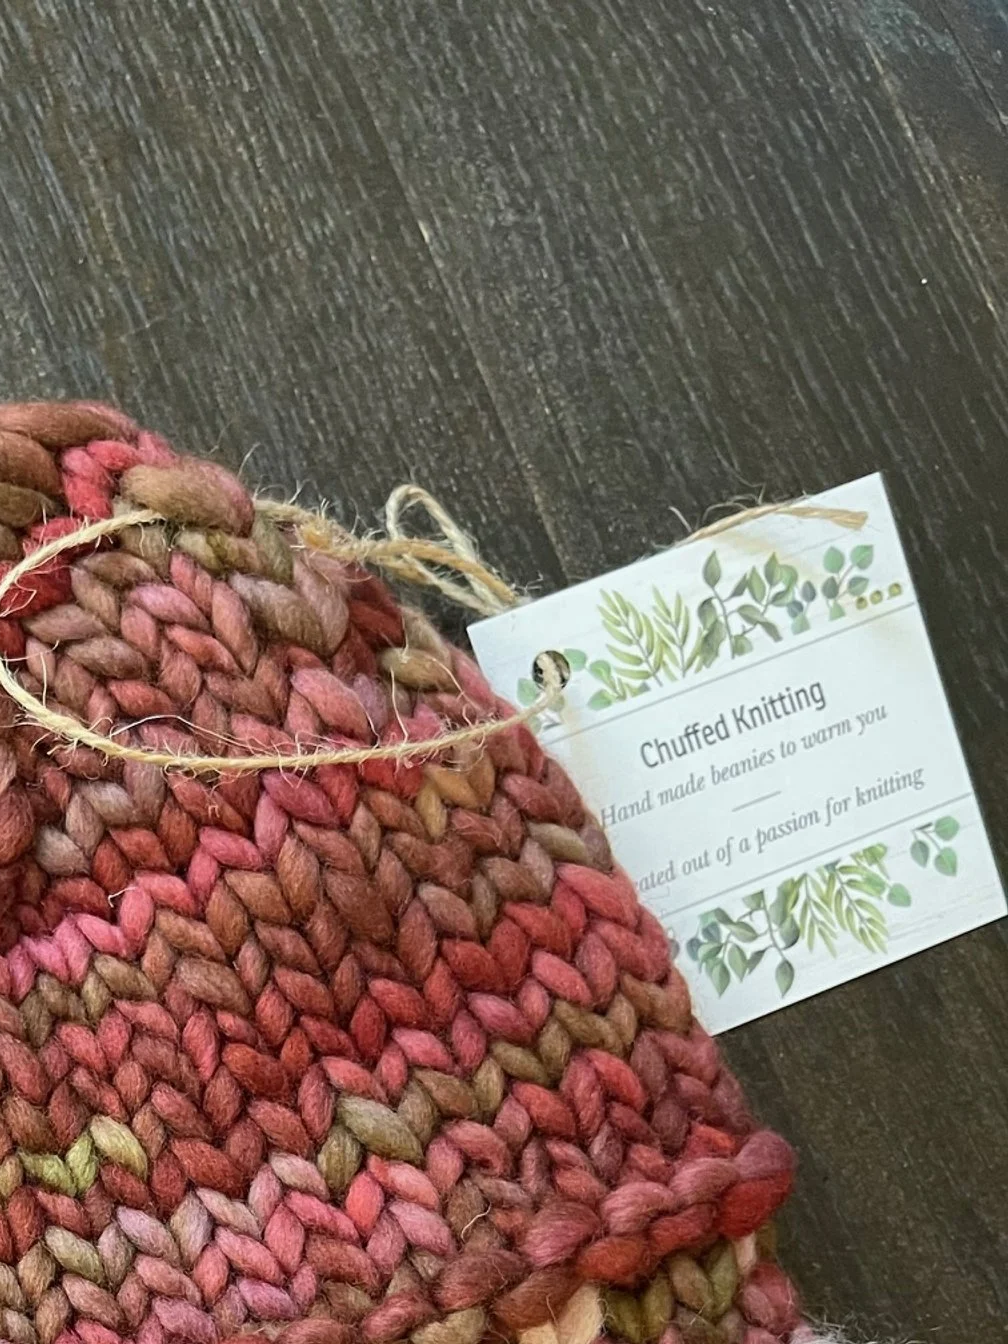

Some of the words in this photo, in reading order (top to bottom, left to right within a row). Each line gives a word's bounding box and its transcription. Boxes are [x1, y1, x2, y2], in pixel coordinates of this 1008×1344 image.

[600, 790, 654, 827] Hand
[657, 773, 706, 806] made
[710, 748, 776, 786] beanies
[780, 740, 797, 759] to
[800, 718, 853, 750] warm
[855, 705, 888, 736] you
[640, 713, 730, 768] Chuffed
[732, 682, 827, 734] Knitting
[635, 860, 677, 893] ated
[682, 850, 710, 876] out
[716, 837, 734, 867] of
[739, 837, 751, 853] a
[756, 812, 821, 854] passion
[825, 797, 852, 827] for
[855, 768, 925, 807] knitting
